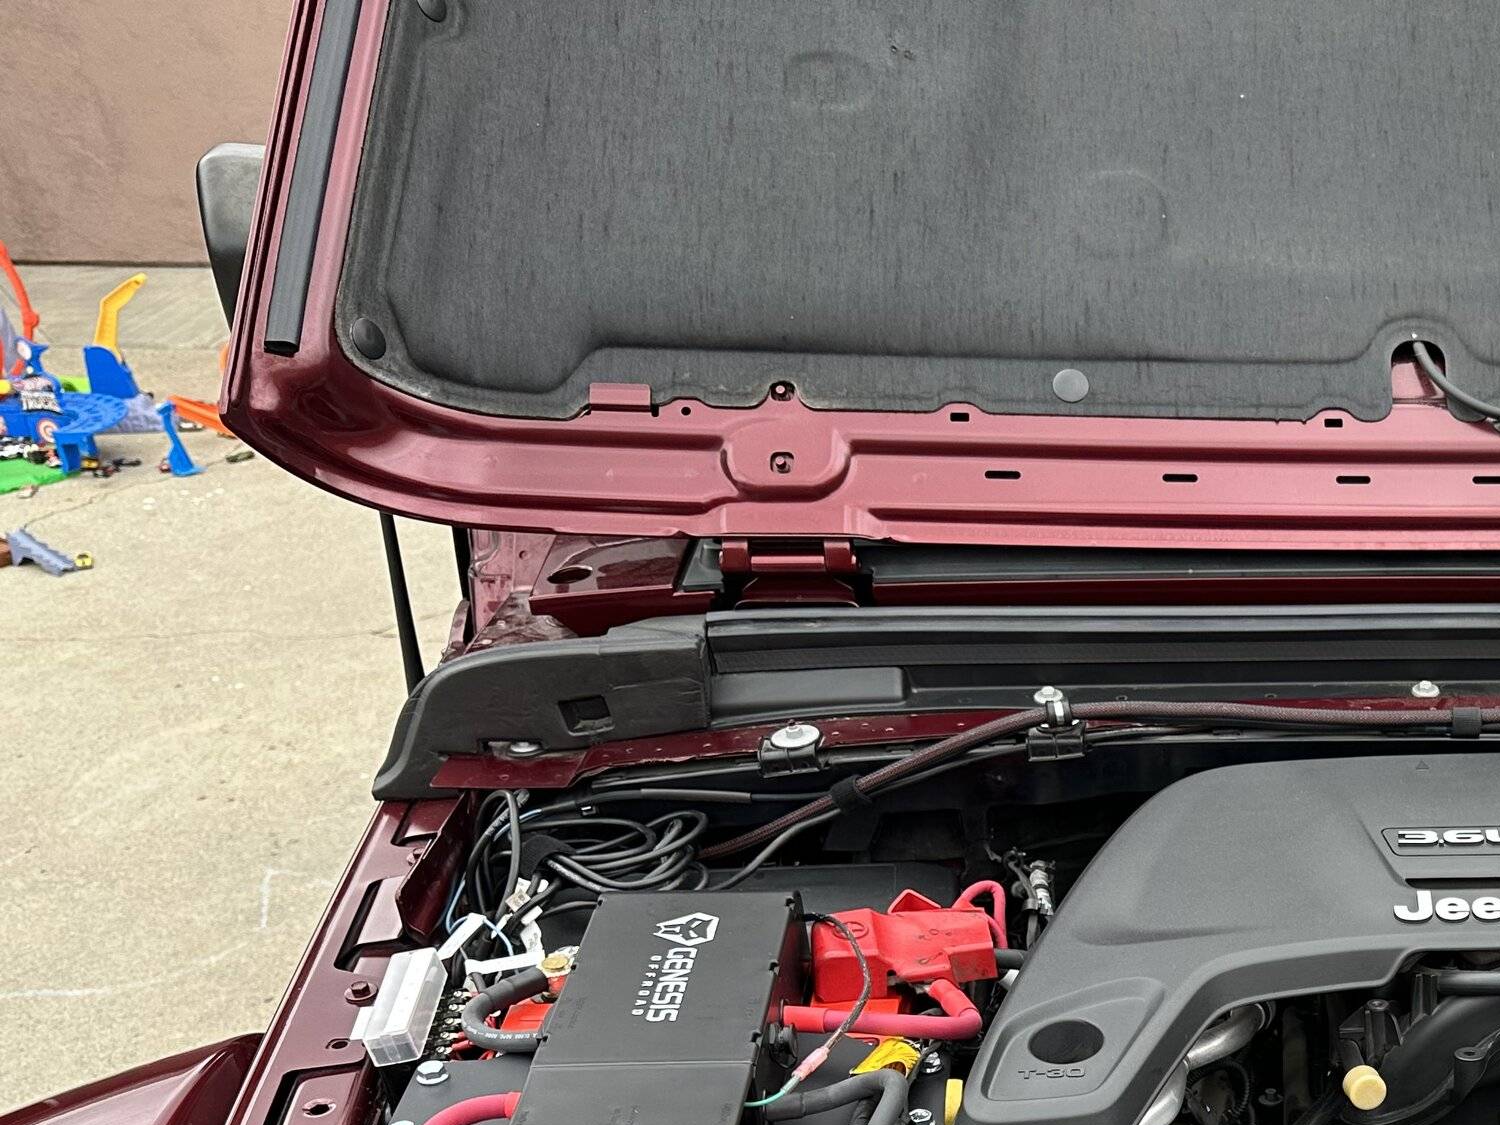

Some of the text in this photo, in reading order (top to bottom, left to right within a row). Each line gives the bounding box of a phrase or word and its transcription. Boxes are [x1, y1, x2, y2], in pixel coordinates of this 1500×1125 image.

[631, 955, 662, 1016] OFFROAD
[645, 947, 698, 1022] GENESIS
[1017, 1068, 1086, 1080] T-30
